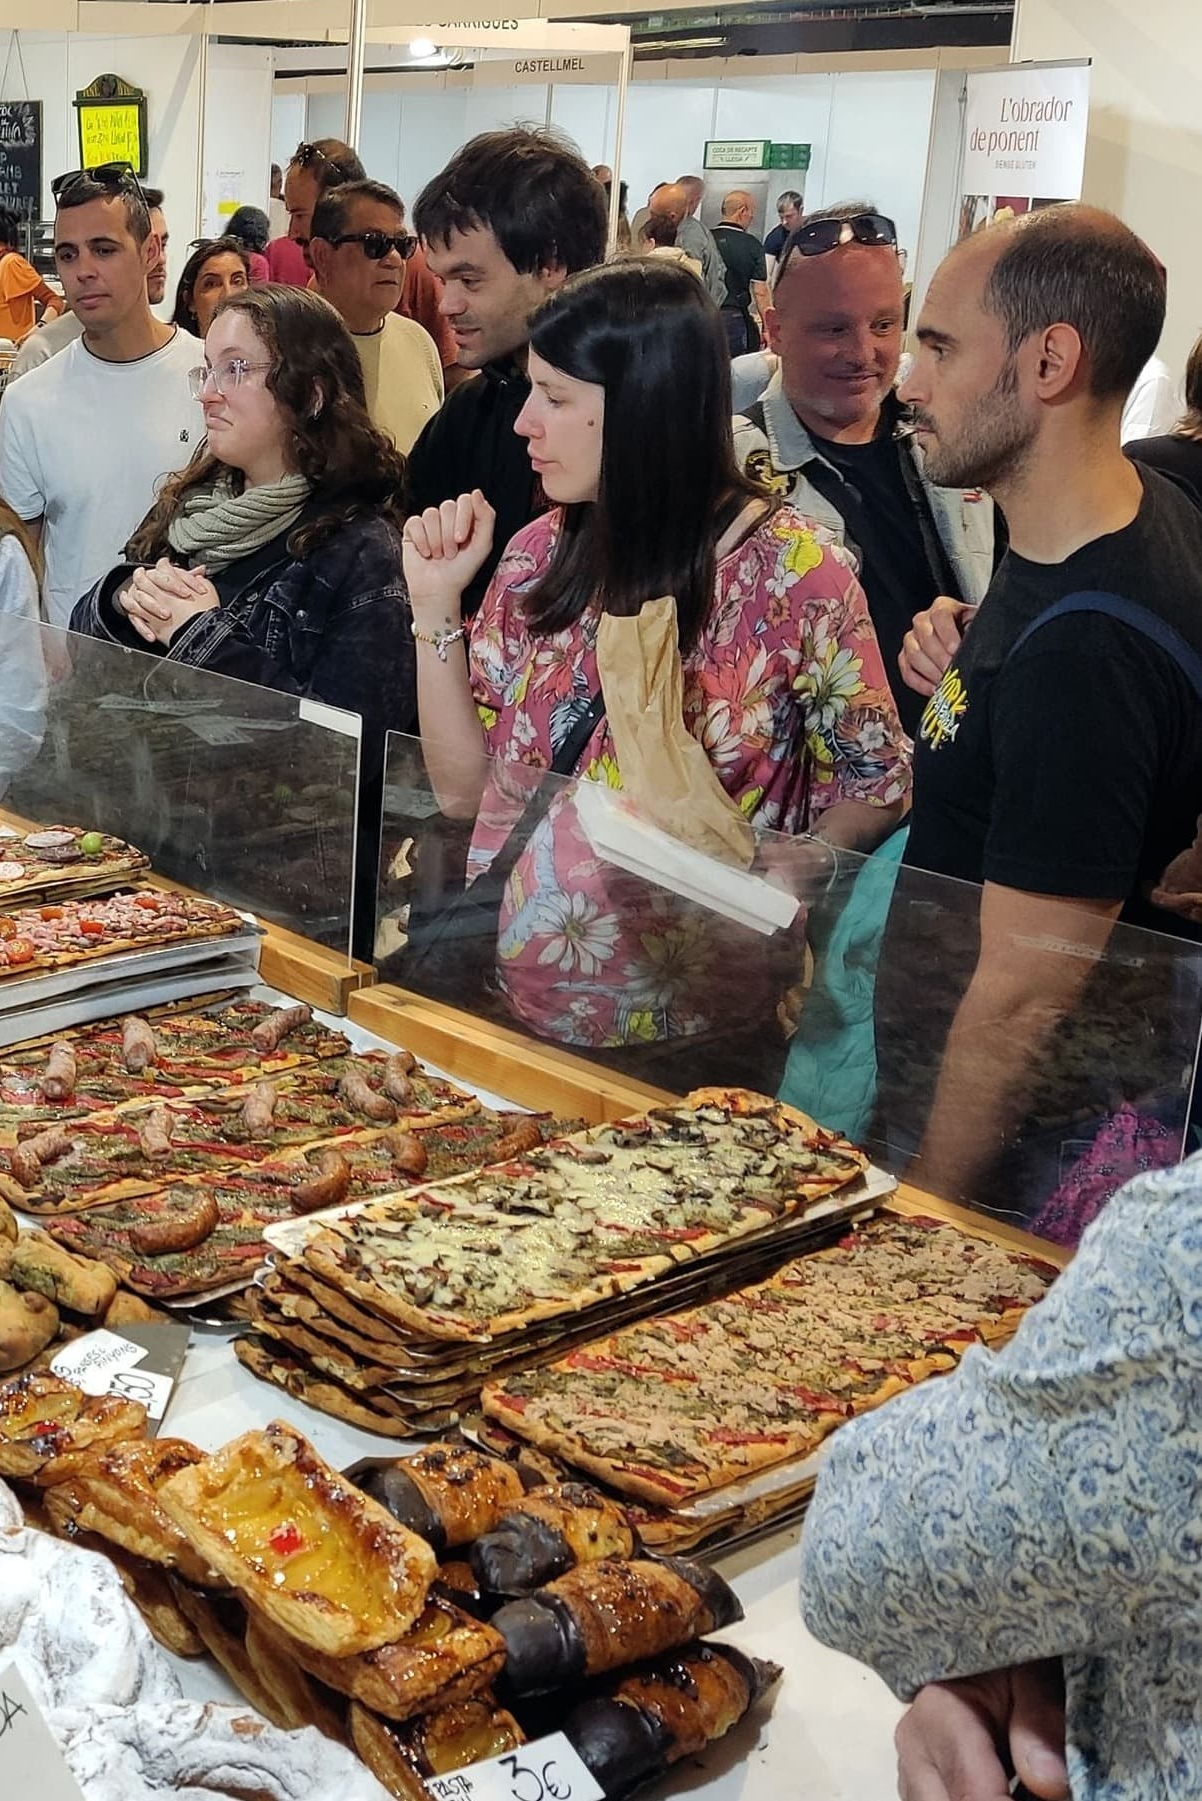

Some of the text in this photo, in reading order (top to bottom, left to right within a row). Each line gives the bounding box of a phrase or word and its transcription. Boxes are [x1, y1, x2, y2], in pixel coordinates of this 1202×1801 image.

[515, 58, 585, 73] CASTELLMEL
[1000, 96, 1073, 122] L'obrador
[969, 127, 1040, 157] de ponent
[499, 1755, 572, 1801] 3€
